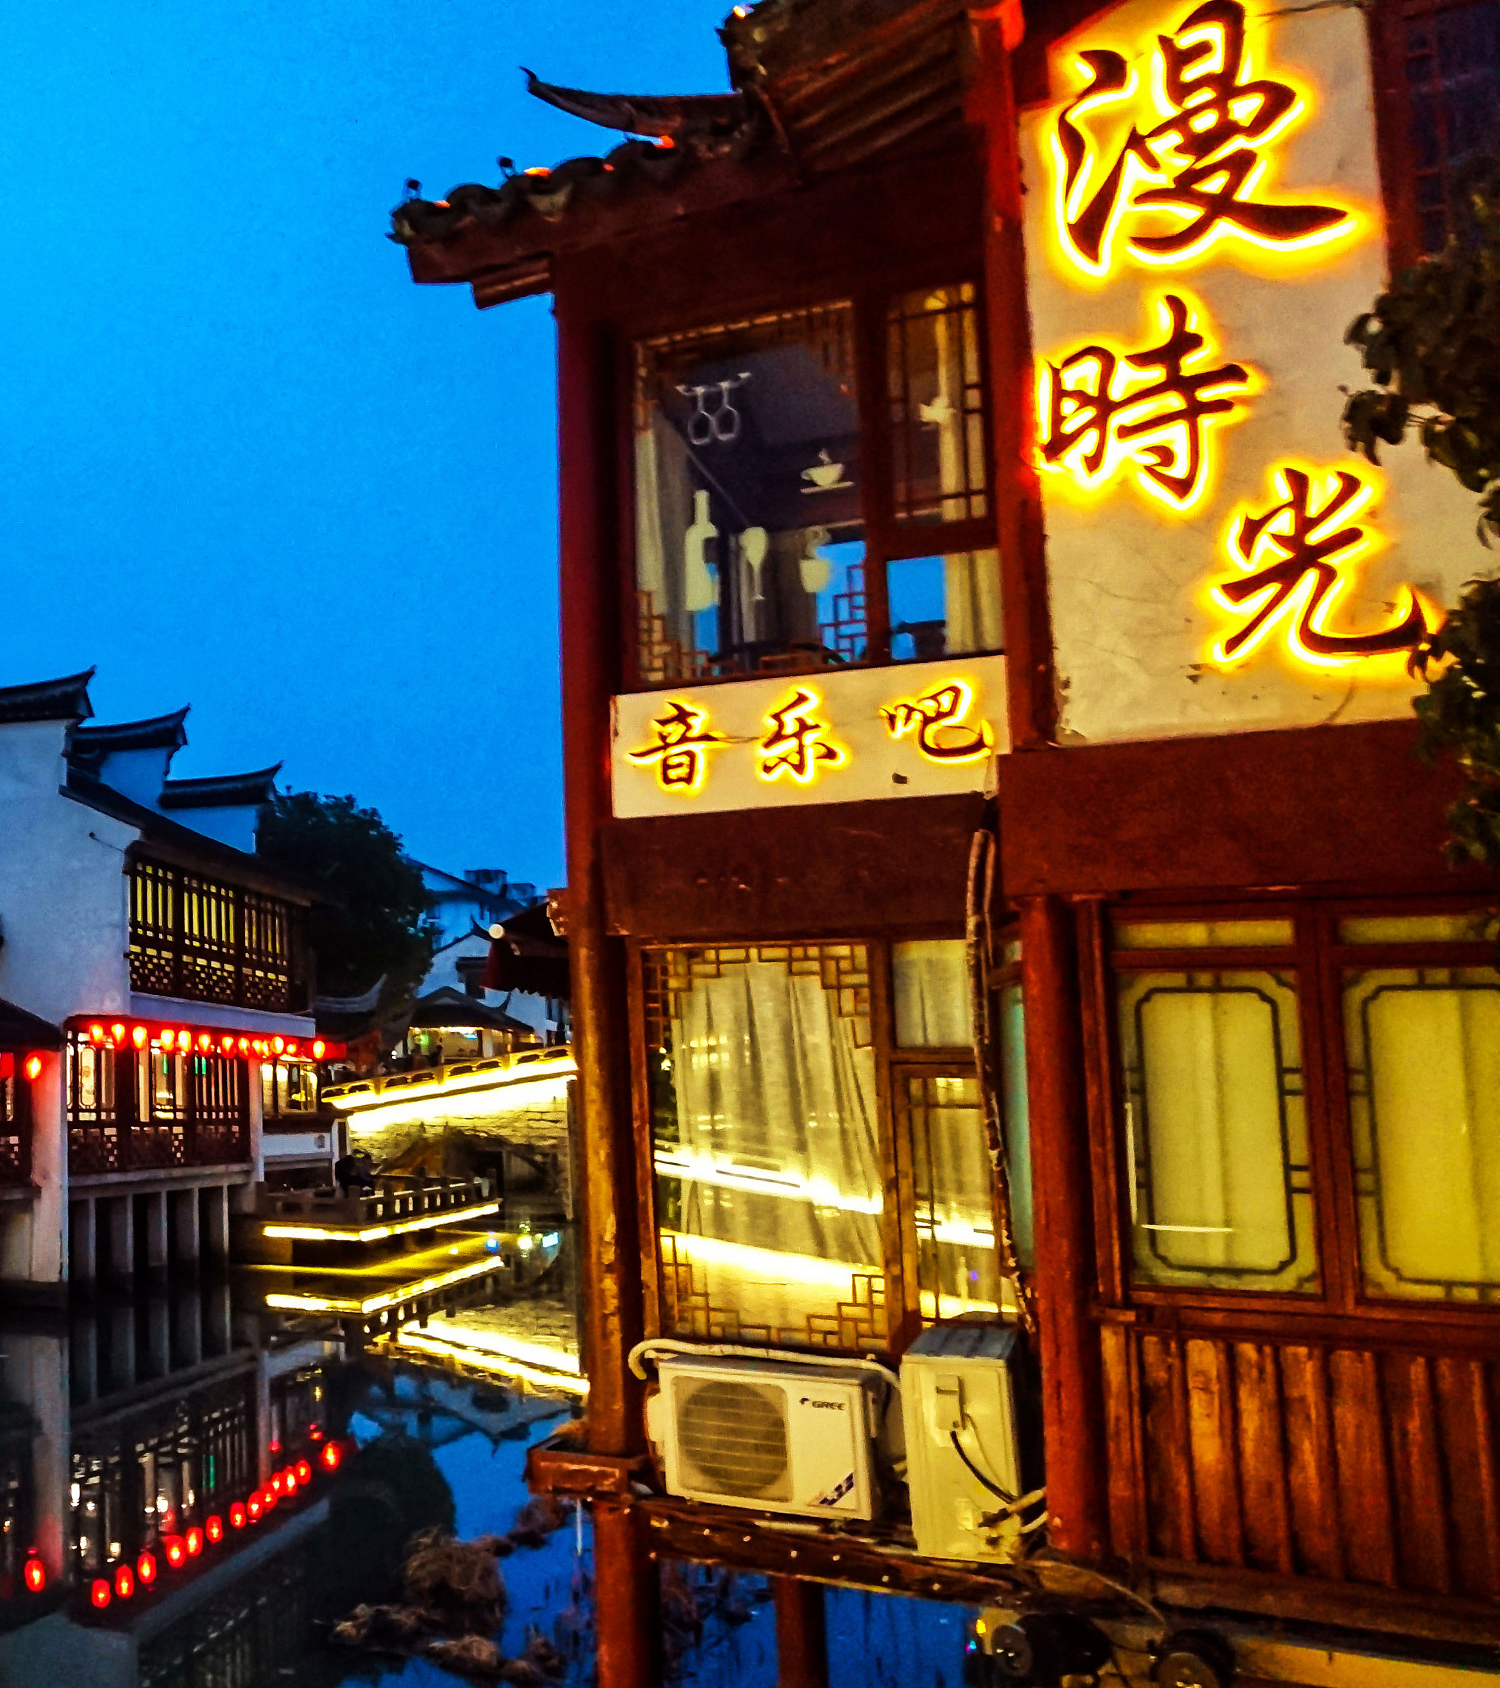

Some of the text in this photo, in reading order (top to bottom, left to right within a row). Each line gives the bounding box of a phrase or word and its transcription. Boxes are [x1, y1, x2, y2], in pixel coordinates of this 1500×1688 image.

[1038, 0, 1428, 656] 漫時光
[628, 685, 992, 786] 音乐吧
[812, 1400, 846, 1411] GREE
